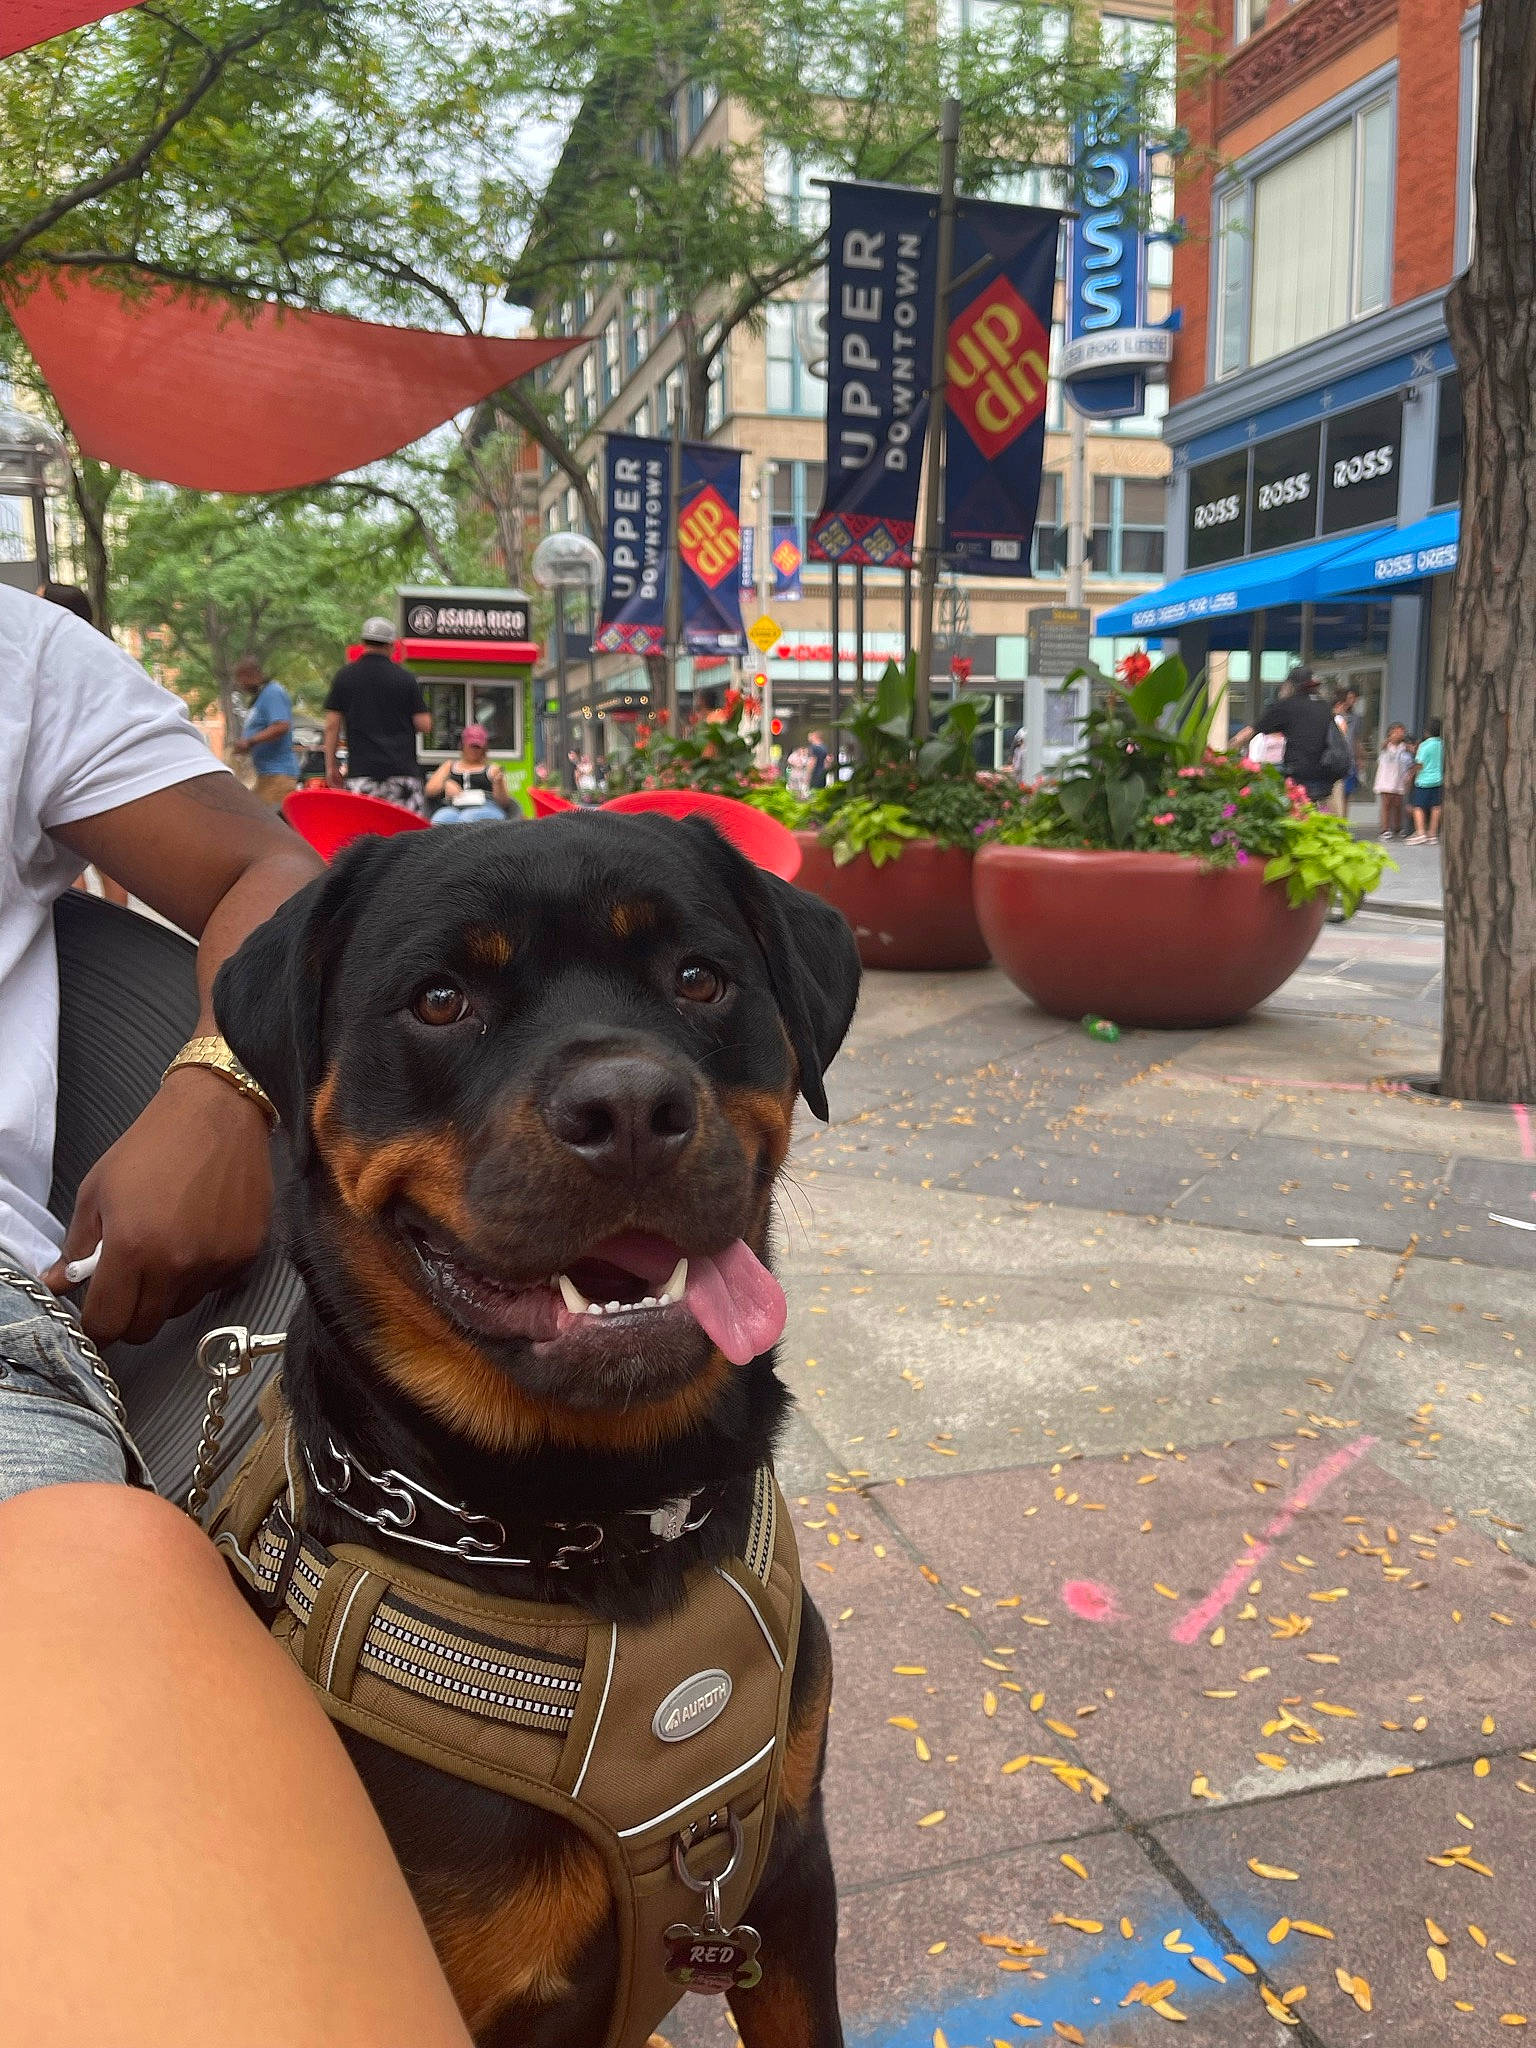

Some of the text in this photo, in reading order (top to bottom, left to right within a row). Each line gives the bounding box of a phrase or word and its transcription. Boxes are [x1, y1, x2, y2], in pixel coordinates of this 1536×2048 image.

[1080, 93, 1129, 330] ROSS
[841, 229, 885, 470] UPPER
[885, 232, 921, 472] DOWNTOWN
[1333, 444, 1394, 489] ROSS
[1194, 494, 1240, 530] ROSS
[1258, 471, 1311, 512] ROSS
[611, 457, 641, 599] UPPER
[640, 459, 663, 600] DOWNTOWN
[437, 607, 486, 628] ASADA
[486, 609, 526, 630] RICO
[682, 1682, 727, 1723] AUROTH
[689, 1945, 735, 1963] RED
